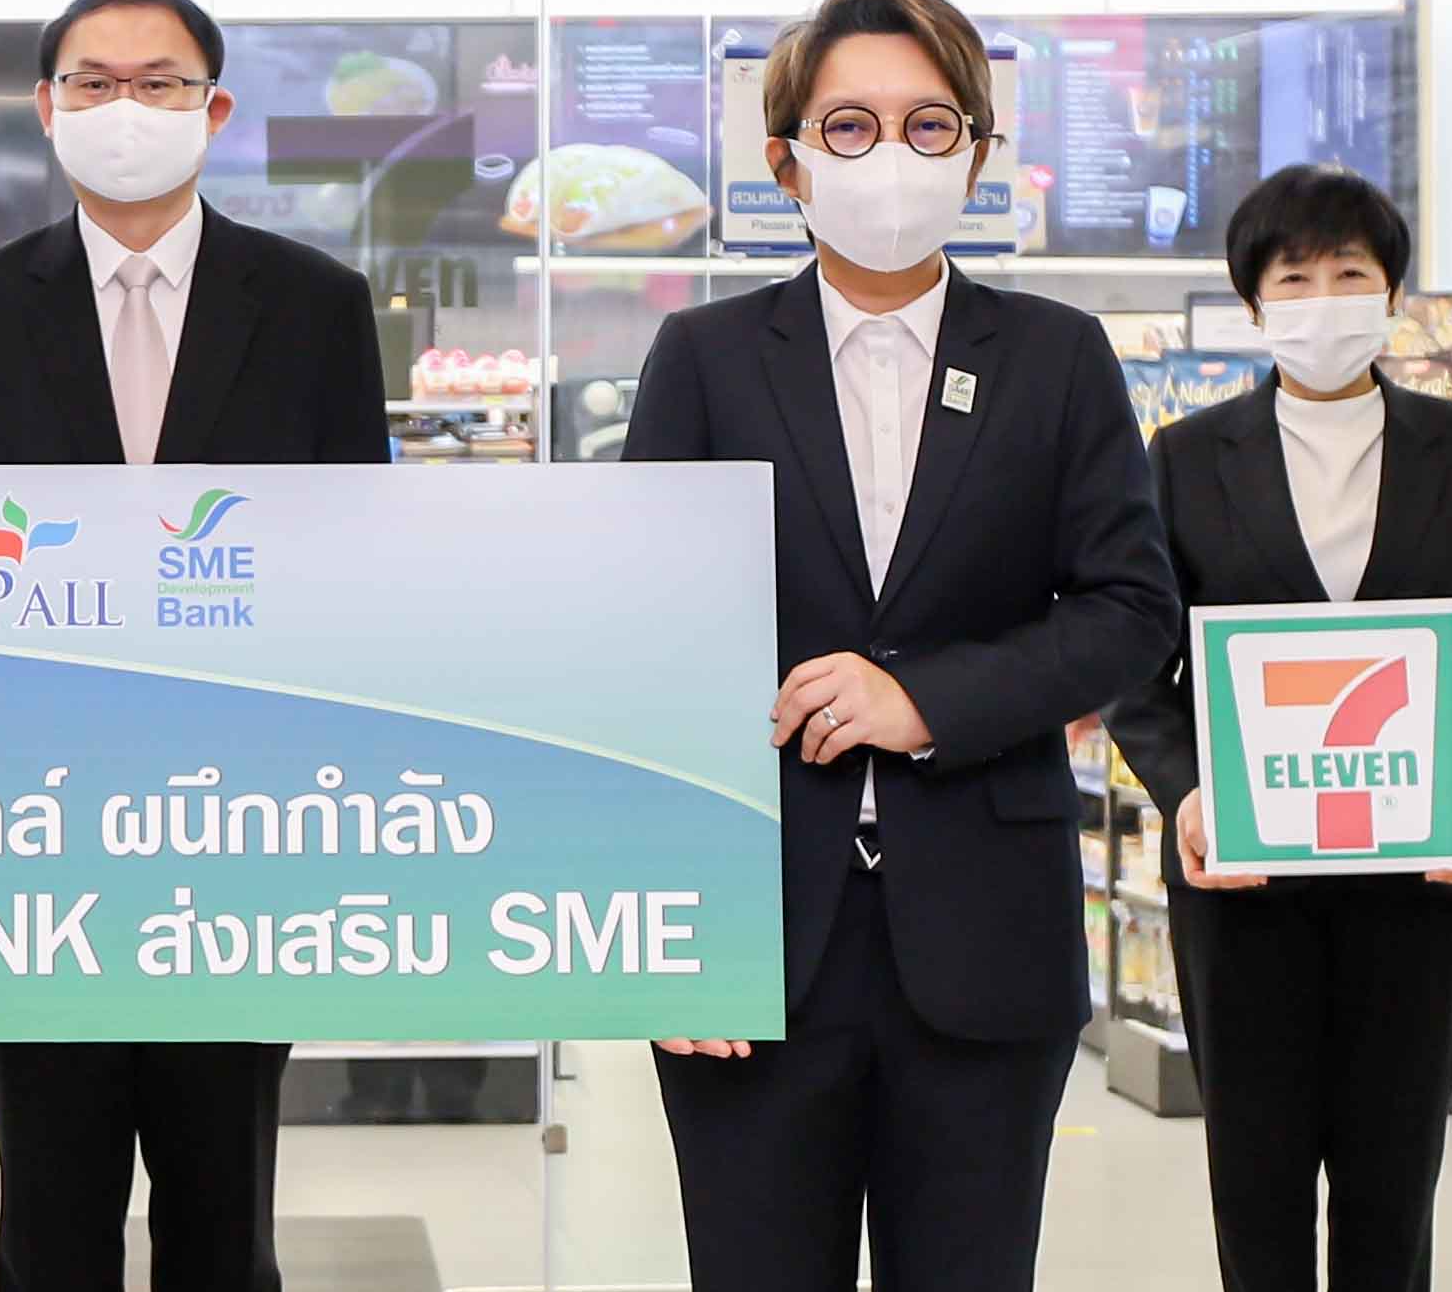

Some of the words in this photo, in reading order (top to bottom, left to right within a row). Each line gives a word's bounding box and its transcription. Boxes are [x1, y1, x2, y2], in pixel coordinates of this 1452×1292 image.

[157, 546, 255, 580] SME
[157, 597, 255, 628] Bank
[101, 765, 493, 856] ผนึกกำลัง
[137, 886, 448, 976] ส่งเสริม
[487, 891, 700, 976] SME
